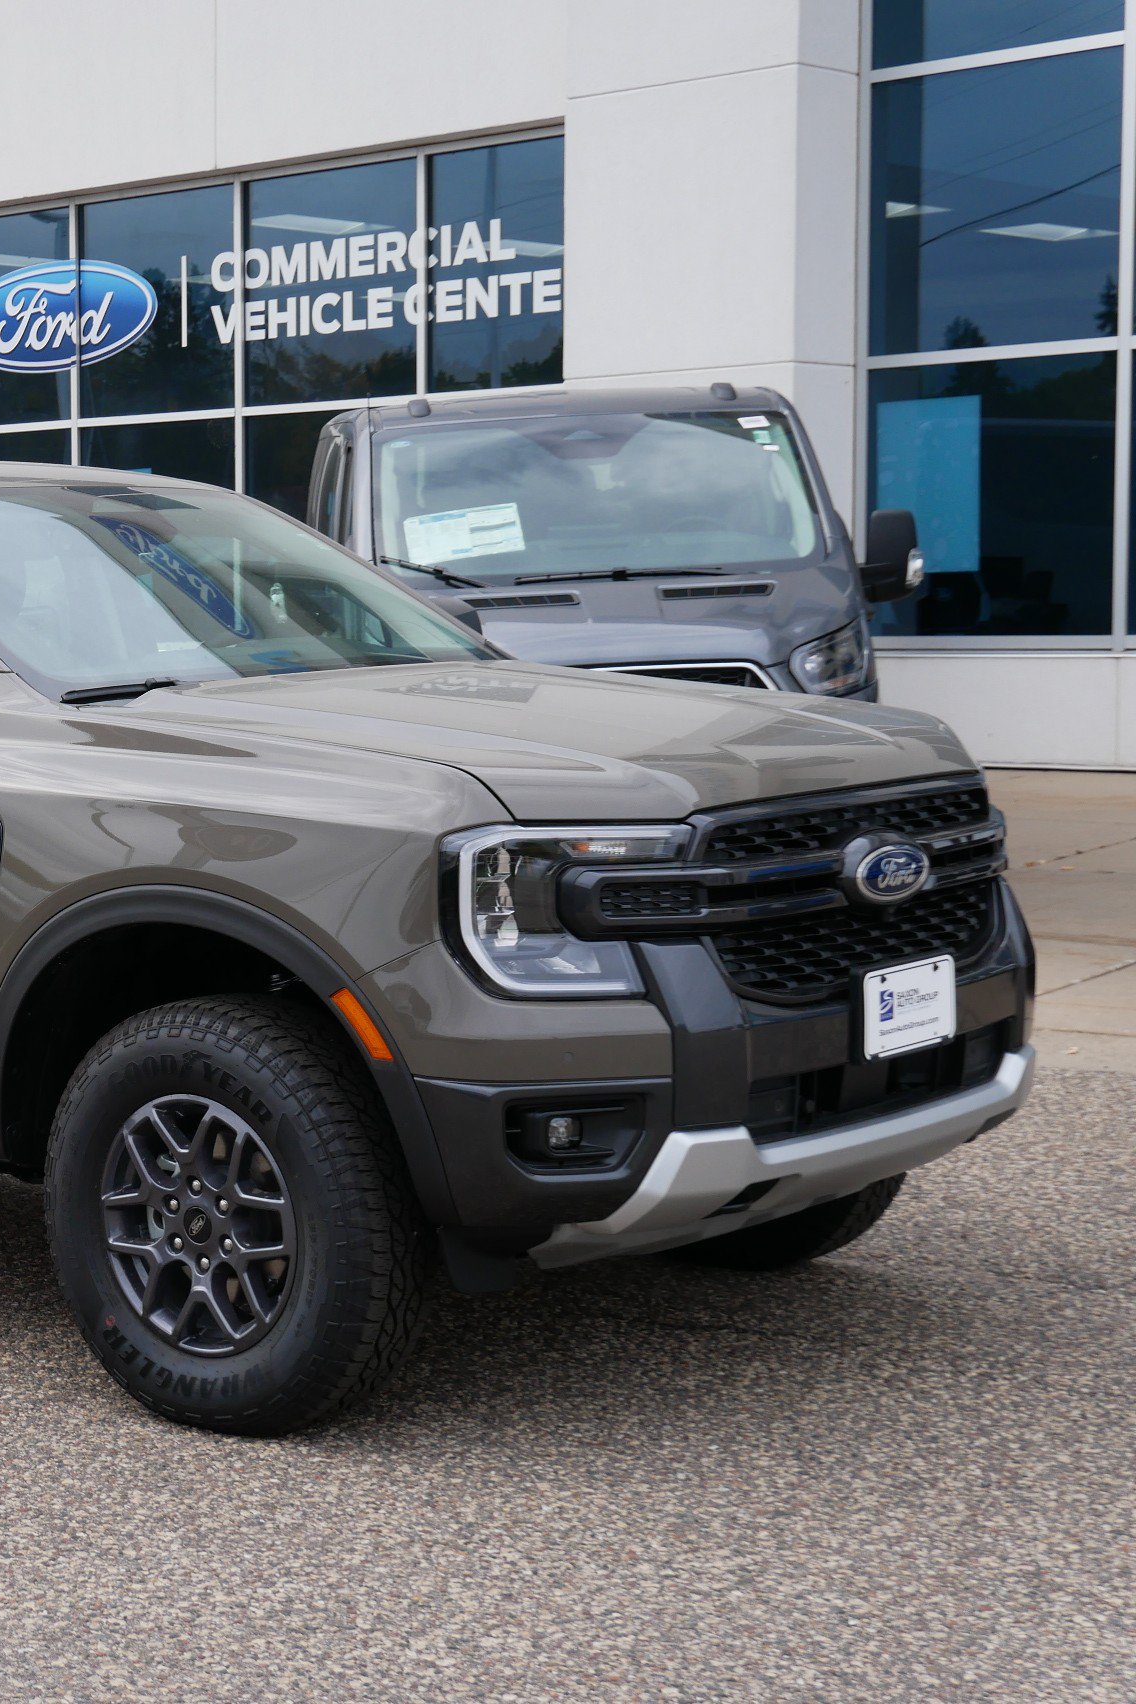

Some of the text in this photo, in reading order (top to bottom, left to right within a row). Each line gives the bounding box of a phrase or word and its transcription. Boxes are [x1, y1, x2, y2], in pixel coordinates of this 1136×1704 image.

[211, 218, 516, 293] COMMERCIAL
[210, 286, 394, 344] VEHICLE
[877, 857, 917, 889] Ford
